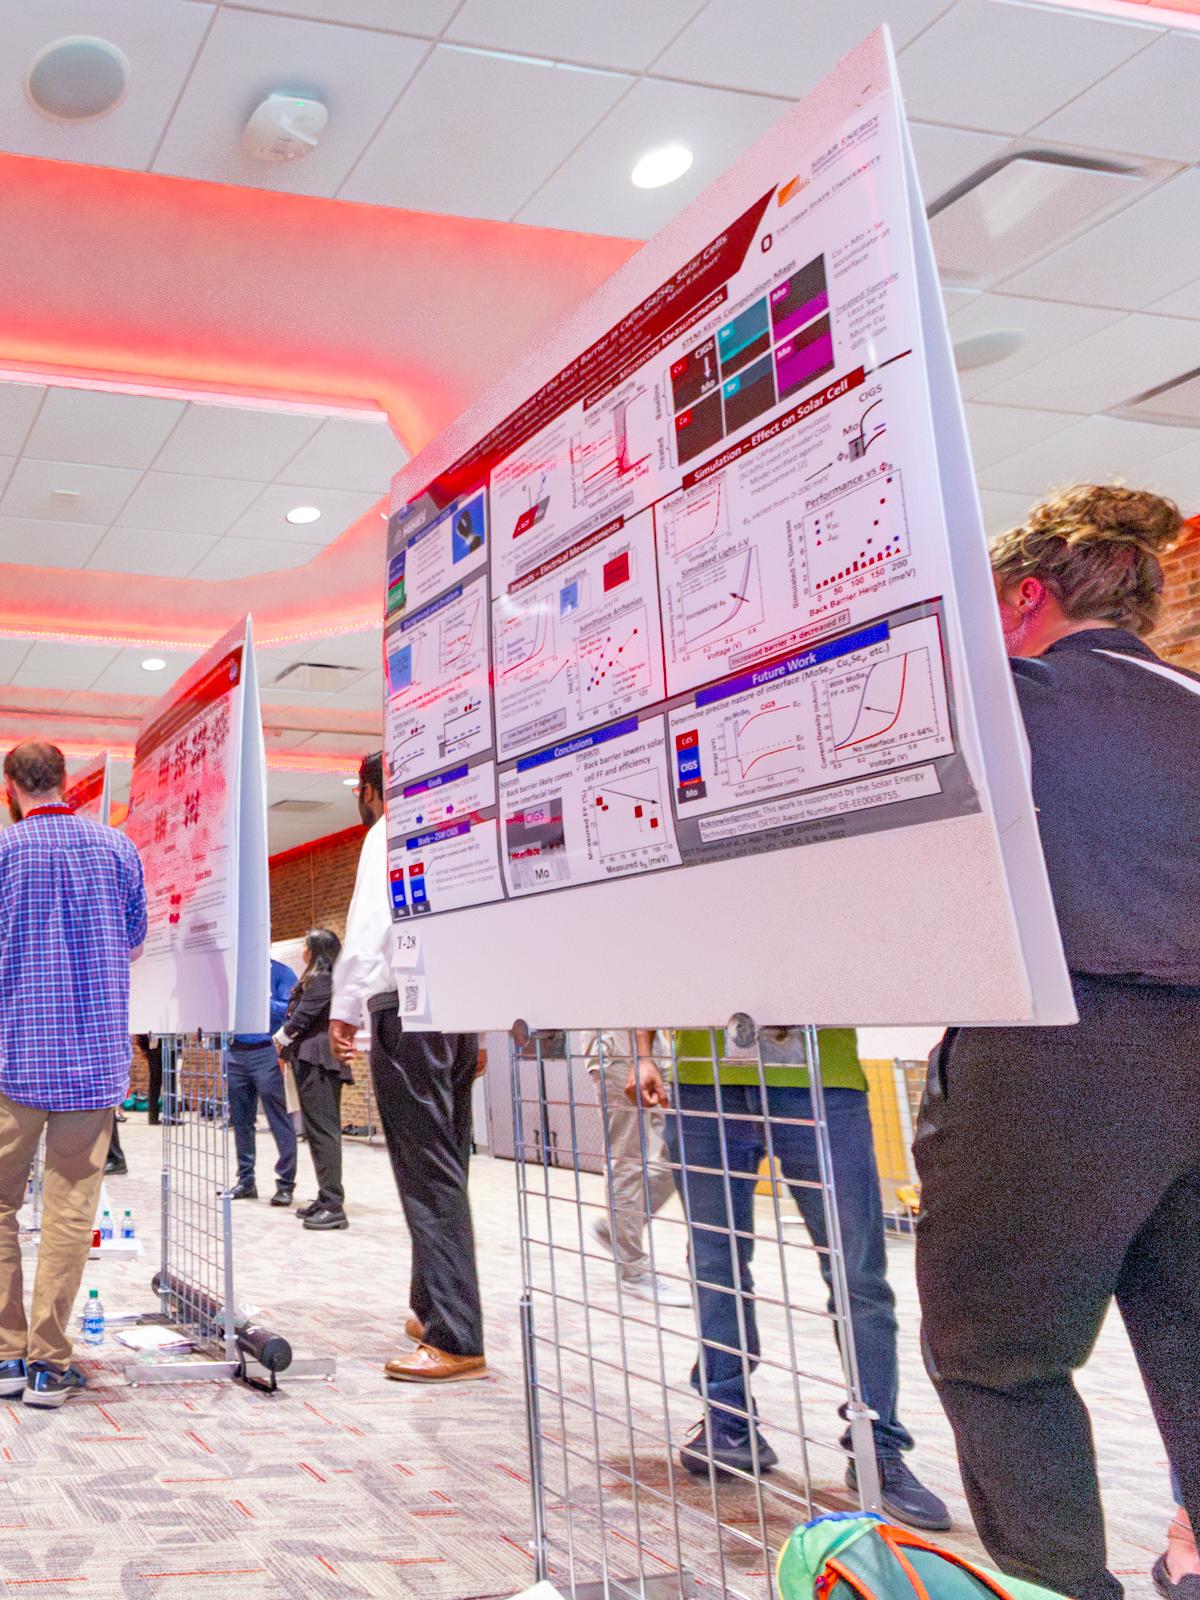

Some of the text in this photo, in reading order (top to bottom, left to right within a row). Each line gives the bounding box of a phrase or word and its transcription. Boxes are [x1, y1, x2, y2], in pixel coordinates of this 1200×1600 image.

[810, 142, 838, 170] SOLAR
[839, 112, 879, 146] ENERGY
[579, 333, 609, 368] Barrier
[675, 253, 702, 285] Solar
[702, 230, 727, 262] Cells
[723, 256, 796, 319] Composition Maps
[771, 284, 786, 303] Mo
[835, 290, 863, 315] Treated
[620, 340, 660, 382] Microscopy
[661, 289, 723, 348] Measurements
[694, 339, 713, 361] CIGS
[776, 342, 792, 361] Mo
[700, 376, 715, 395] Mo
[858, 382, 882, 404] CIGS
[693, 377, 849, 482] Simulation Effect on Solar Cell
[842, 419, 859, 437] Mo
[662, 466, 727, 512] Model Verification
[804, 466, 876, 510] Performance vs
[540, 550, 568, 576] Electrical
[569, 517, 620, 558] Measurements
[784, 518, 794, 558] Decrease
[681, 553, 716, 579] Simulated
[718, 543, 736, 560] Light
[833, 557, 908, 595] 50 100 150 200
[809, 566, 916, 617] Back Barrier Height (meV)
[685, 600, 718, 622] Increasing
[731, 613, 846, 666] Increased barrier decreased FF
[707, 645, 731, 662] Voltage
[751, 651, 817, 685] Future Work
[670, 708, 704, 727] Determine
[705, 700, 730, 716] precise
[731, 690, 755, 706] nature
[765, 674, 799, 694] interface
[868, 642, 890, 659] etc.)
[829, 678, 843, 689] With
[759, 699, 776, 711] CIGS
[553, 734, 593, 758] Conclusions
[681, 735, 693, 745] CdS
[852, 744, 863, 754] No
[898, 732, 909, 741] FF
[575, 746, 599, 761] Impacts
[583, 735, 664, 771] Back barrier lowers solar
[869, 752, 908, 770] Voltage (V)
[584, 772, 594, 783] cell
[604, 764, 617, 776] and
[618, 753, 651, 773] efficiency
[679, 759, 697, 774] CIGS
[427, 774, 442, 789] Goals
[506, 770, 572, 797] Back barrier likely comes
[685, 787, 698, 798] Mo
[762, 805, 776, 815] This
[778, 800, 795, 811] work
[804, 788, 844, 806] supported
[845, 786, 855, 797] by
[855, 782, 870, 793] the
[871, 777, 893, 790] Solar
[894, 769, 925, 786] Energy
[506, 784, 562, 809] from interfacial layer
[525, 808, 544, 824] CIGS
[702, 825, 737, 840] Technology
[737, 820, 756, 832] Office
[758, 815, 781, 828] (SETO)
[782, 810, 804, 822] Award
[806, 803, 837, 817] Number
[417, 835, 429, 847] Study
[446, 826, 457, 838] CIGS
[583, 817, 593, 861] Measured
[534, 867, 549, 880] Mo
[606, 860, 637, 874] Measured
[397, 936, 416, 949] T-28
